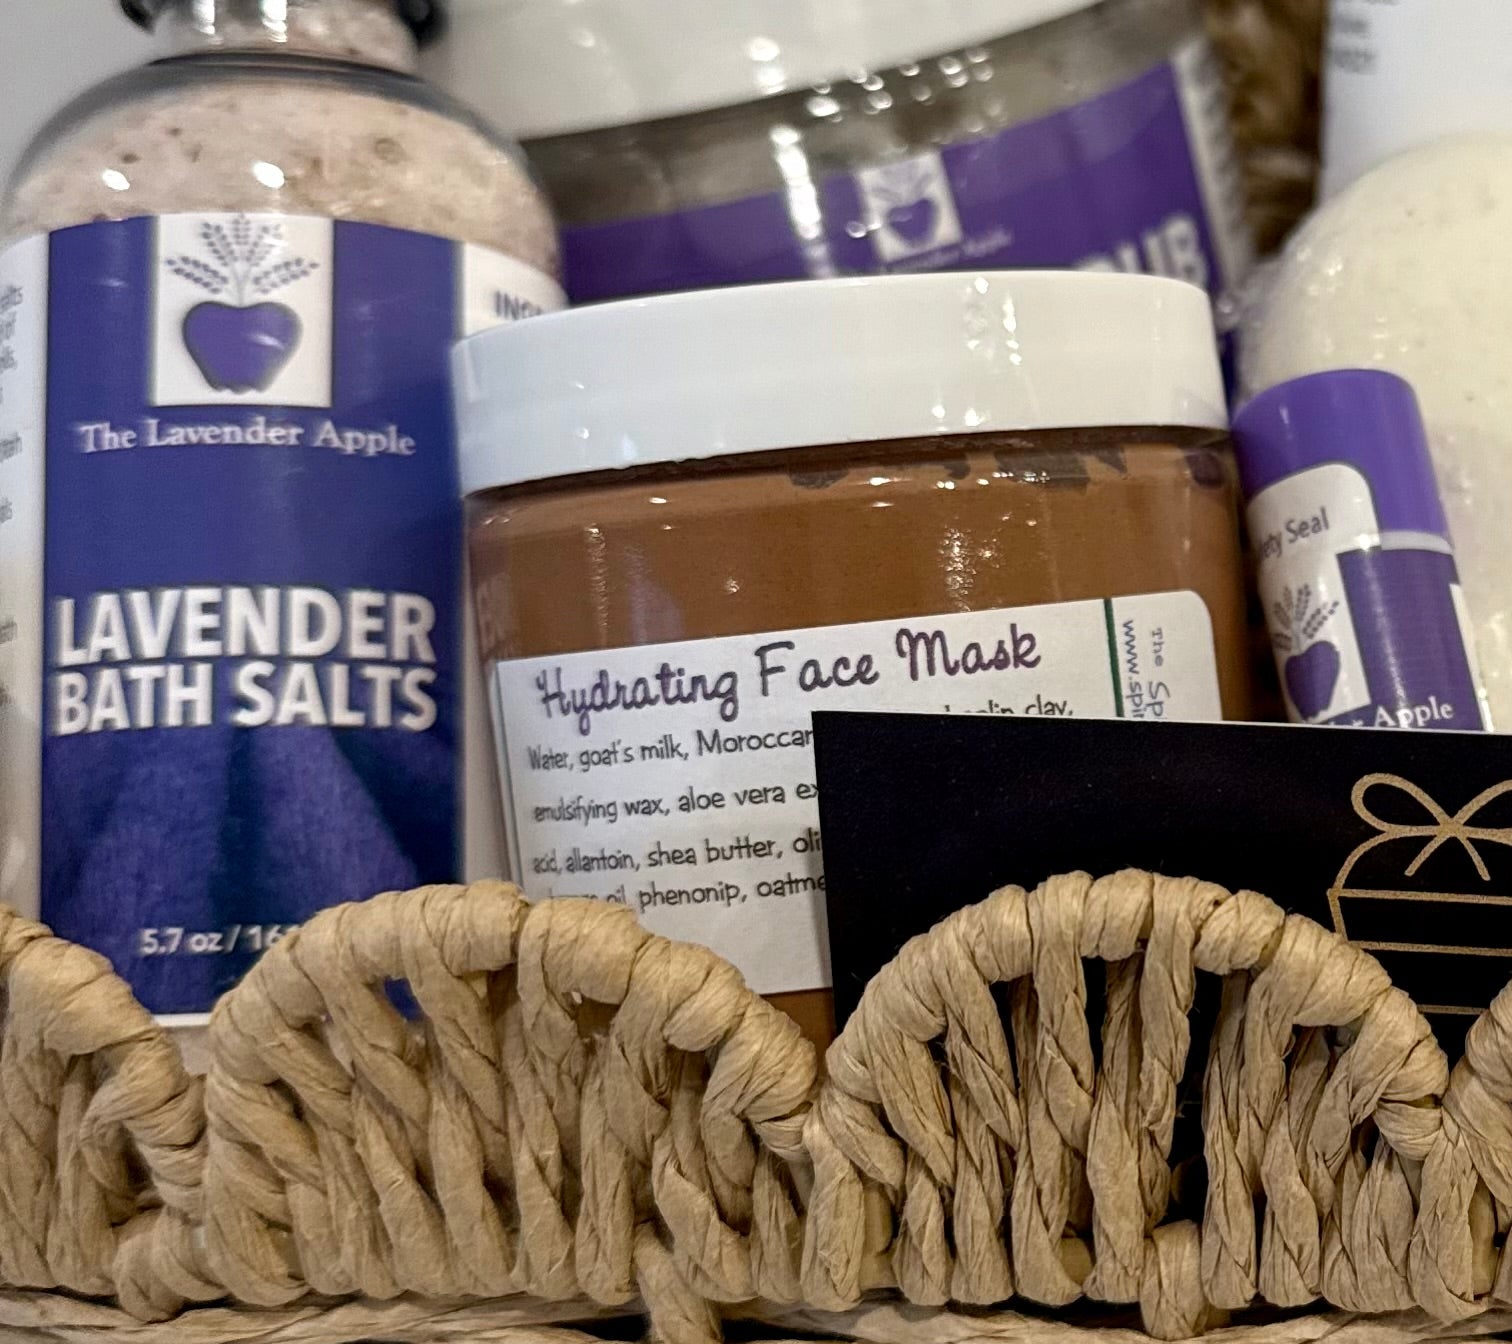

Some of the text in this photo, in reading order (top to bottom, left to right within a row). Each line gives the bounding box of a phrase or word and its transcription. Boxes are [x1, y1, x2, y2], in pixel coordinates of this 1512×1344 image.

[81, 416, 417, 456] The Lavender Apple
[1285, 506, 1329, 545] Seal
[56, 586, 437, 667] LAVENDER
[1150, 626, 1164, 667] The
[56, 660, 438, 736] BATH SALTS
[536, 622, 1042, 736] Hydrating Face Mask
[1374, 695, 1454, 729] Apple
[527, 742, 575, 771] Water,
[579, 738, 634, 773] goat's
[641, 733, 689, 762] milk,
[534, 795, 618, 826] emulsifying
[624, 797, 671, 817] wax,
[679, 785, 725, 813] aloe
[735, 784, 787, 806] vera
[565, 846, 641, 874] allantoin,
[648, 840, 698, 868] shea
[704, 832, 784, 863] butter,
[639, 880, 748, 913] phenonip,
[142, 927, 184, 955] 5.7
[190, 931, 224, 953] oz
